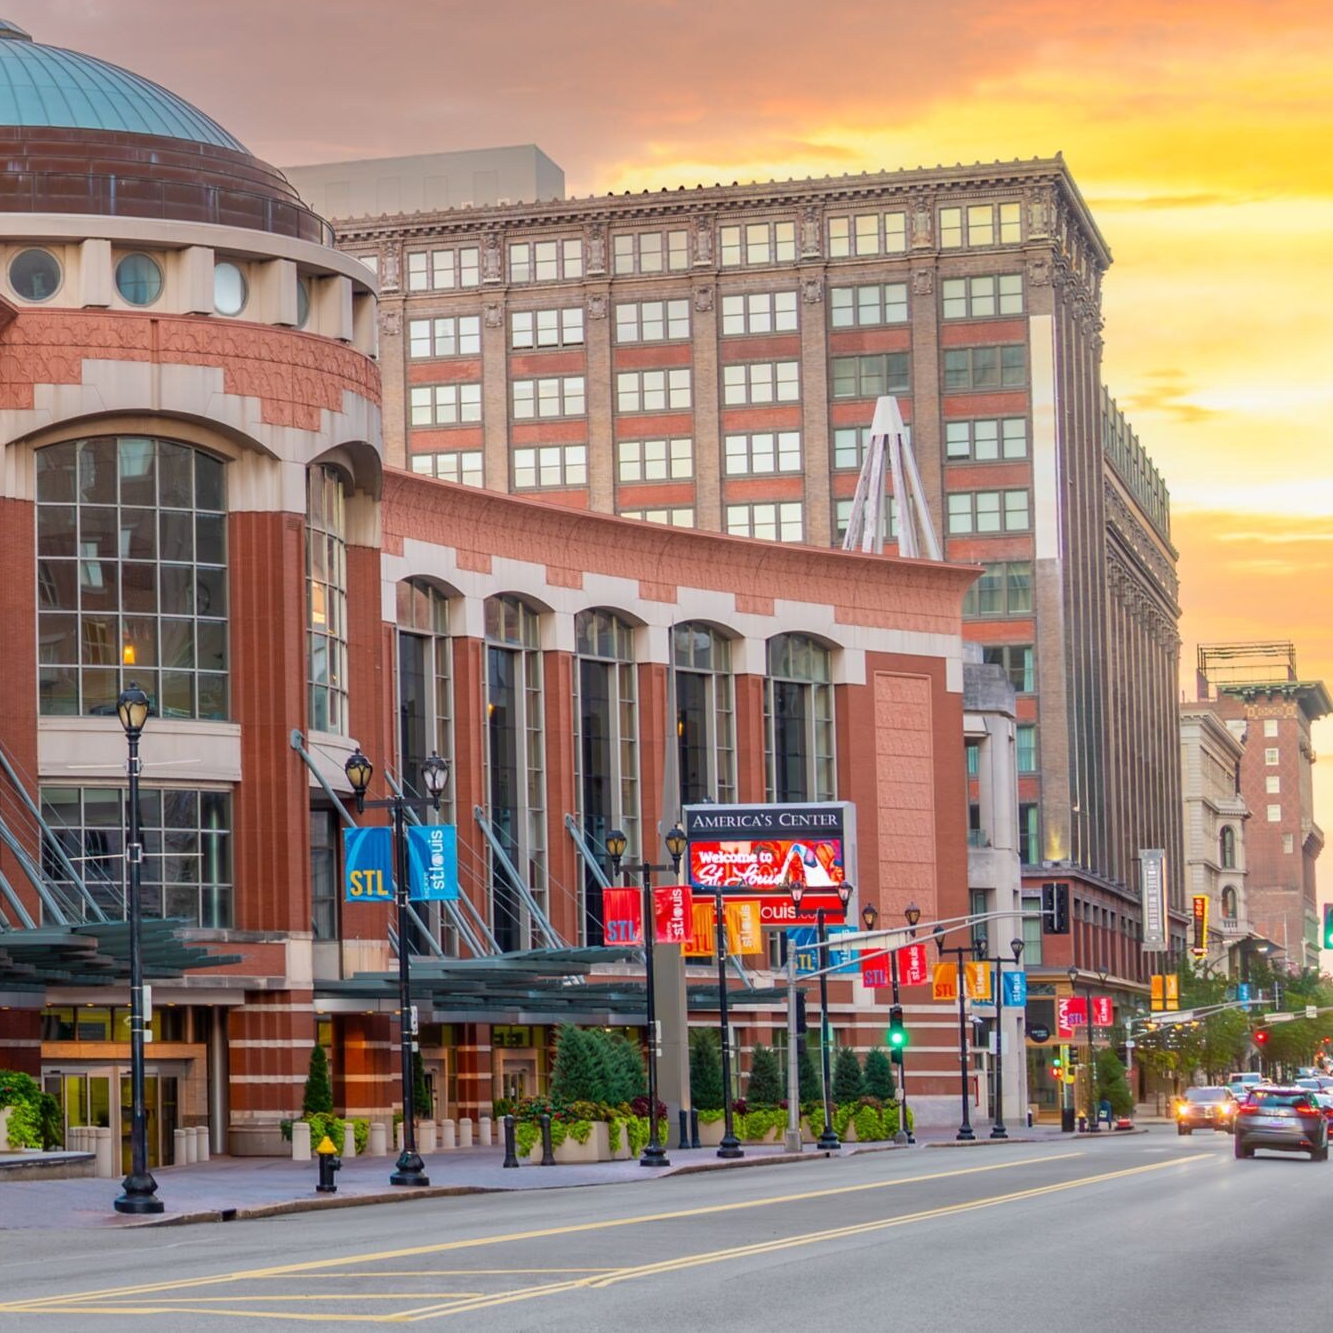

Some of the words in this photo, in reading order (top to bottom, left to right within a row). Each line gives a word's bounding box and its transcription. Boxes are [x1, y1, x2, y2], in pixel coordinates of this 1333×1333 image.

[692, 813, 772, 828] AMERICA'S
[779, 813, 838, 827] CENTER
[698, 850, 758, 864] Welcome
[760, 851, 773, 863] to
[350, 869, 389, 896] STL
[607, 920, 638, 942] STL
[865, 969, 887, 985] STL
[935, 984, 954, 997] STL
